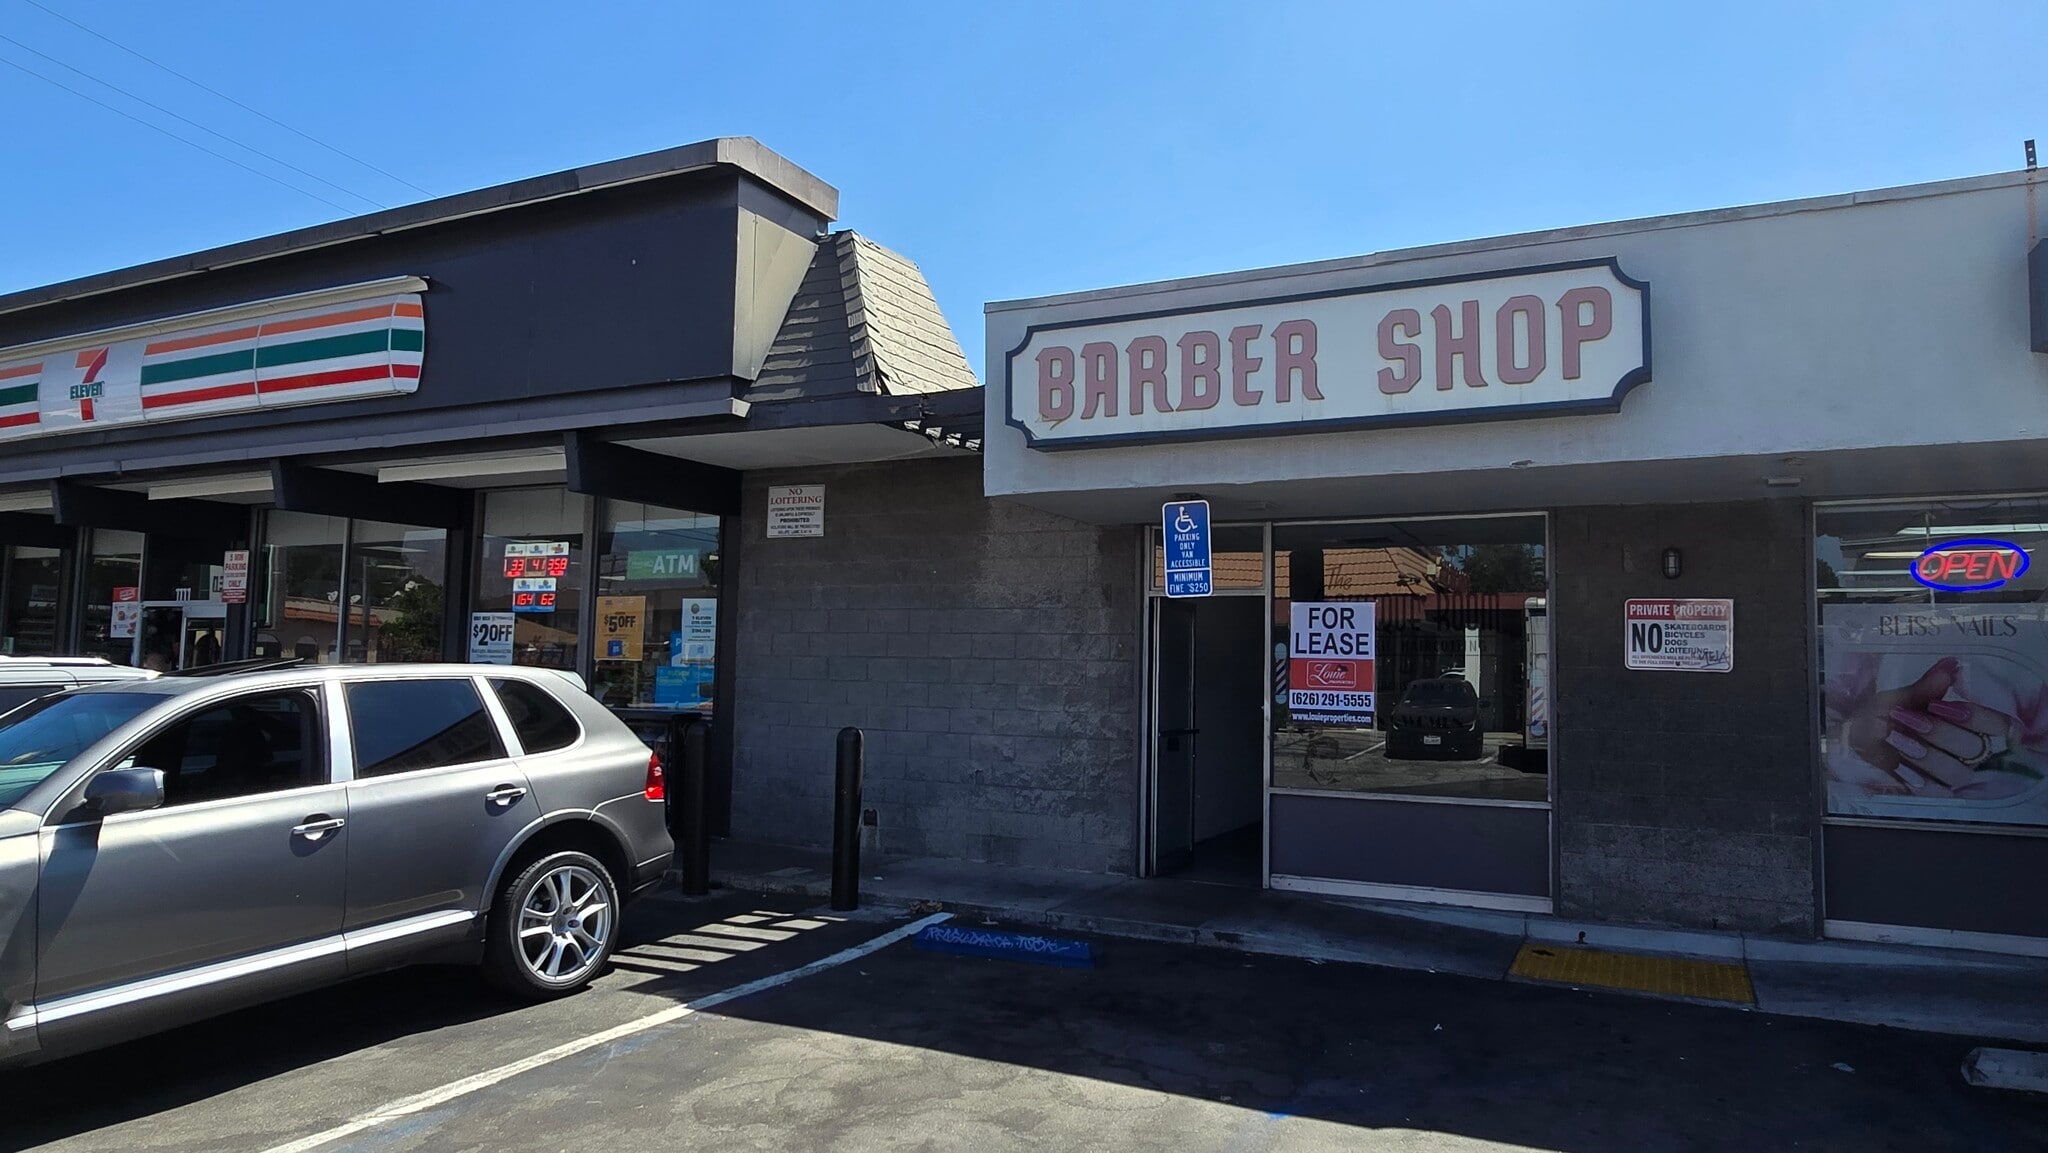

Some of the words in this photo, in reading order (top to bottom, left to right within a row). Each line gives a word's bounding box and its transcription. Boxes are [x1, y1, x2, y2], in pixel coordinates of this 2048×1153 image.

[1035, 319, 1325, 422] BARBER
[1376, 286, 1613, 395] SHOP
[788, 488, 803, 496] NO
[770, 495, 822, 505] LOITERING
[1174, 532, 1200, 542] PARKING
[1179, 542, 1195, 551] ONLY
[1181, 550, 1194, 559] VAN
[224, 562, 247, 571] PARKING
[652, 554, 694, 574] ATM
[1170, 558, 1206, 569] ACCESSIBLE
[1918, 551, 2017, 581] OPEN
[1174, 571, 1204, 582] MINIMUM
[229, 580, 241, 588] ONLY
[1169, 583, 1185, 594] FINE
[1187, 582, 1209, 593] $250
[1629, 604, 1671, 616] PRIVATE
[1673, 604, 1727, 617] PROPERTY
[604, 614, 618, 633] $5
[618, 615, 637, 628] OFF
[1308, 606, 1355, 630] FOR
[1664, 623, 1727, 632] SKATEBOARDS
[1879, 615, 1940, 637] BLISS
[1952, 615, 2018, 638] NAILS
[473, 623, 489, 646] $2
[489, 624, 513, 642] OFF
[1631, 622, 1663, 653] NO
[1664, 631, 1706, 639] BICYCLES
[1294, 632, 1370, 656] LEASE
[1664, 639, 1688, 647] DOGS
[1664, 646, 1709, 655] LOITERING
[1310, 663, 1347, 685] Louie
[1292, 692, 1319, 706] (626)
[1321, 693, 1371, 708] 291-5555
[1292, 712, 1372, 725] www.louieproperties.com
